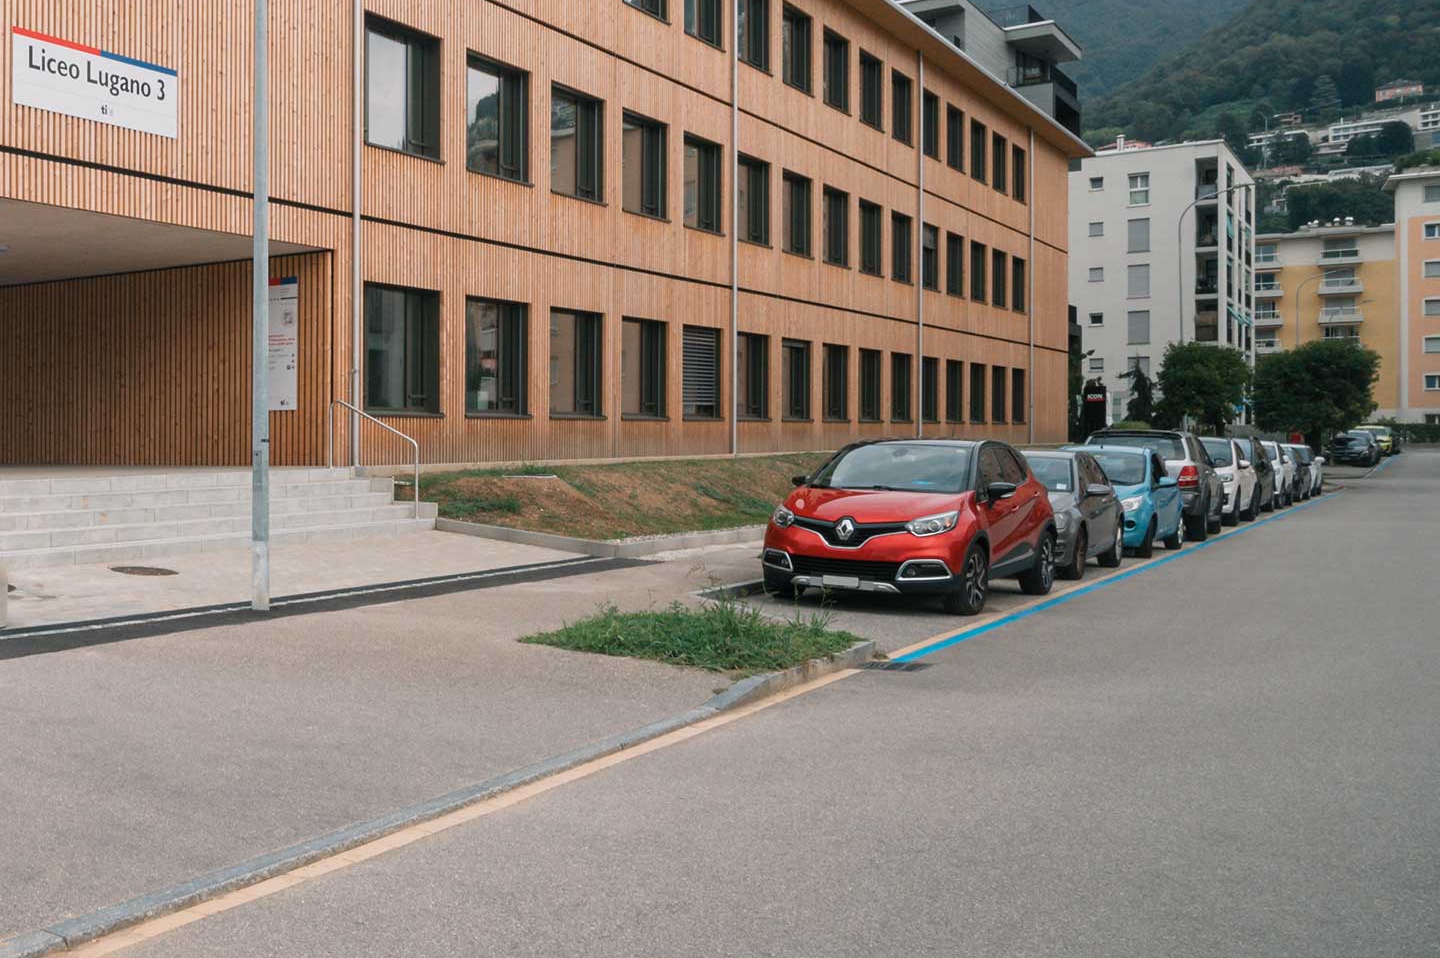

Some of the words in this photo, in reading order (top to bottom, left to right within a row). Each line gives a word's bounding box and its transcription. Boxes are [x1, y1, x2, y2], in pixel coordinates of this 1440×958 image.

[28, 45, 80, 80] Liceo
[86, 60, 151, 97] Lugano
[156, 79, 166, 101] 3
[100, 104, 108, 115] ti
